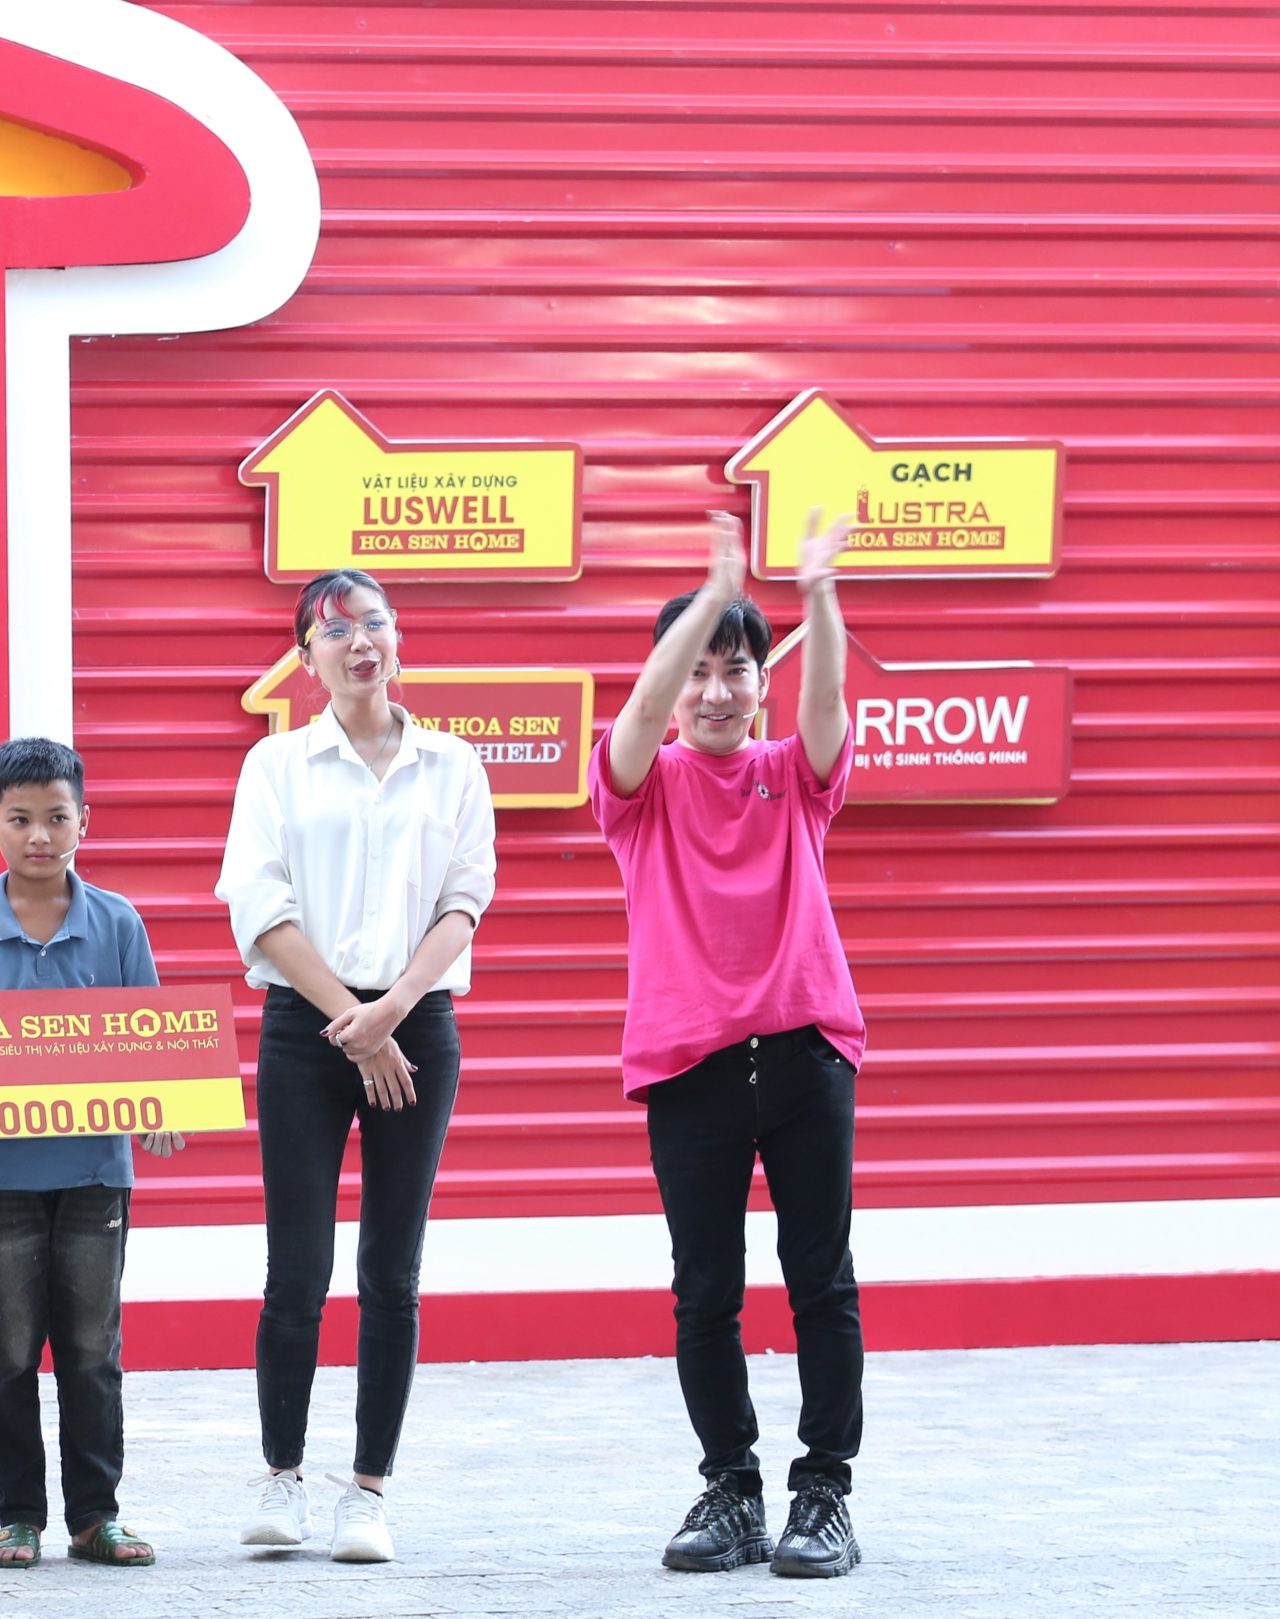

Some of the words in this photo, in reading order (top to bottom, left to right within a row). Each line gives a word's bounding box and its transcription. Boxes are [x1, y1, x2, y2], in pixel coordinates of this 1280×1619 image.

[362, 473, 392, 492] VẬT
[398, 472, 428, 492] LIỆU
[434, 472, 466, 488] XÂY
[472, 474, 517, 491] DỰNG
[891, 463, 971, 488] GẠCH
[363, 495, 514, 525] LUSWELL
[360, 535, 404, 550] HOA
[408, 534, 449, 550] SEN
[454, 531, 520, 551] HOME
[892, 531, 932, 547] SEN
[936, 528, 1000, 548] HOME
[448, 717, 503, 736] HOA
[509, 716, 561, 735] SEN
[854, 695, 1030, 747] RROW
[854, 753, 869, 769] BỊ
[873, 750, 892, 769] VỆ
[896, 752, 931, 766] SINH
[933, 749, 986, 766] THÔNG
[989, 751, 1028, 764] MINH
[20, 1014, 91, 1039] SEN
[101, 1008, 218, 1038] HOME
[0, 1042, 22, 1056] SIÊU
[24, 1044, 42, 1056] THỊ
[44, 1041, 66, 1056] VẬT
[69, 1040, 90, 1055] LIỆU
[93, 1039, 115, 1053] XÂY
[118, 1039, 153, 1054] DỰNG
[155, 1041, 164, 1051] &
[167, 1037, 189, 1052] NỘI
[191, 1036, 219, 1050] THẤT
